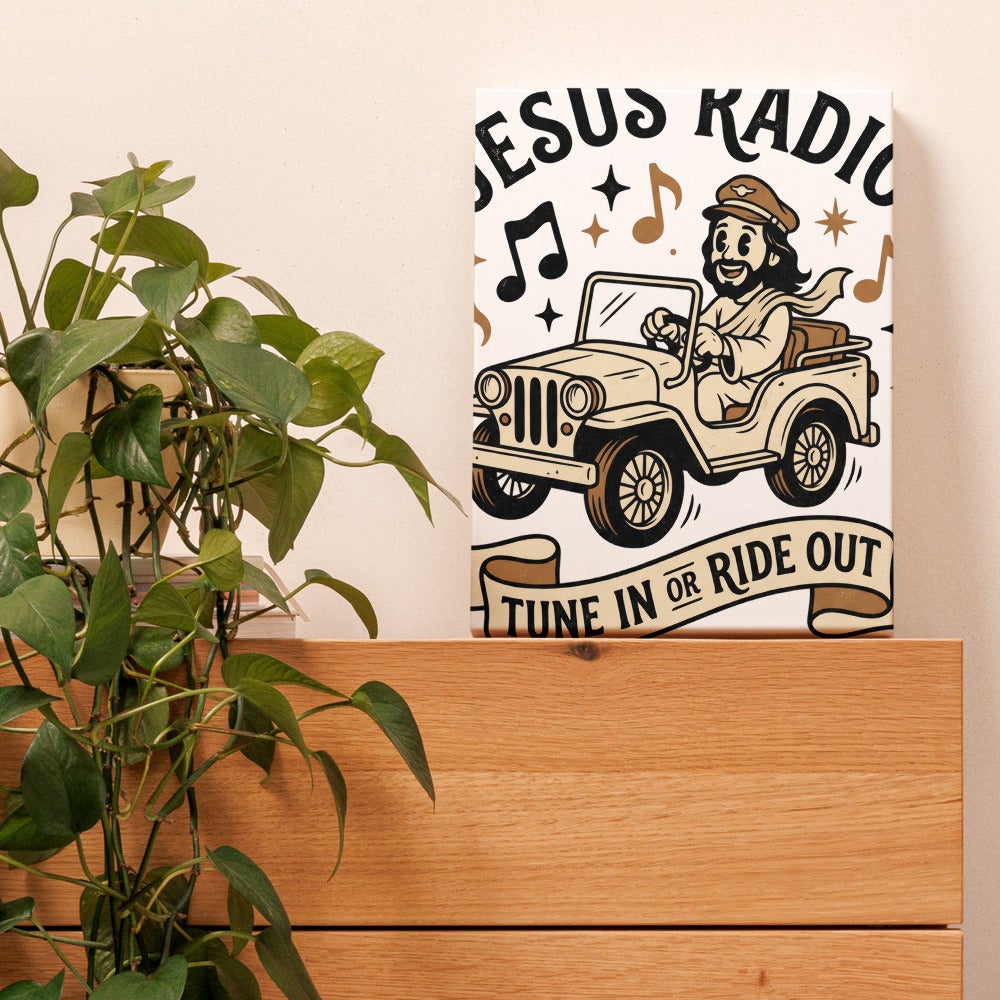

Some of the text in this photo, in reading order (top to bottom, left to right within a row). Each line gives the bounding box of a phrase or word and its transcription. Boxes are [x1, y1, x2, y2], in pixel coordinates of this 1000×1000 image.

[501, 531, 882, 638] TUNE IN OR RIDE OUT
